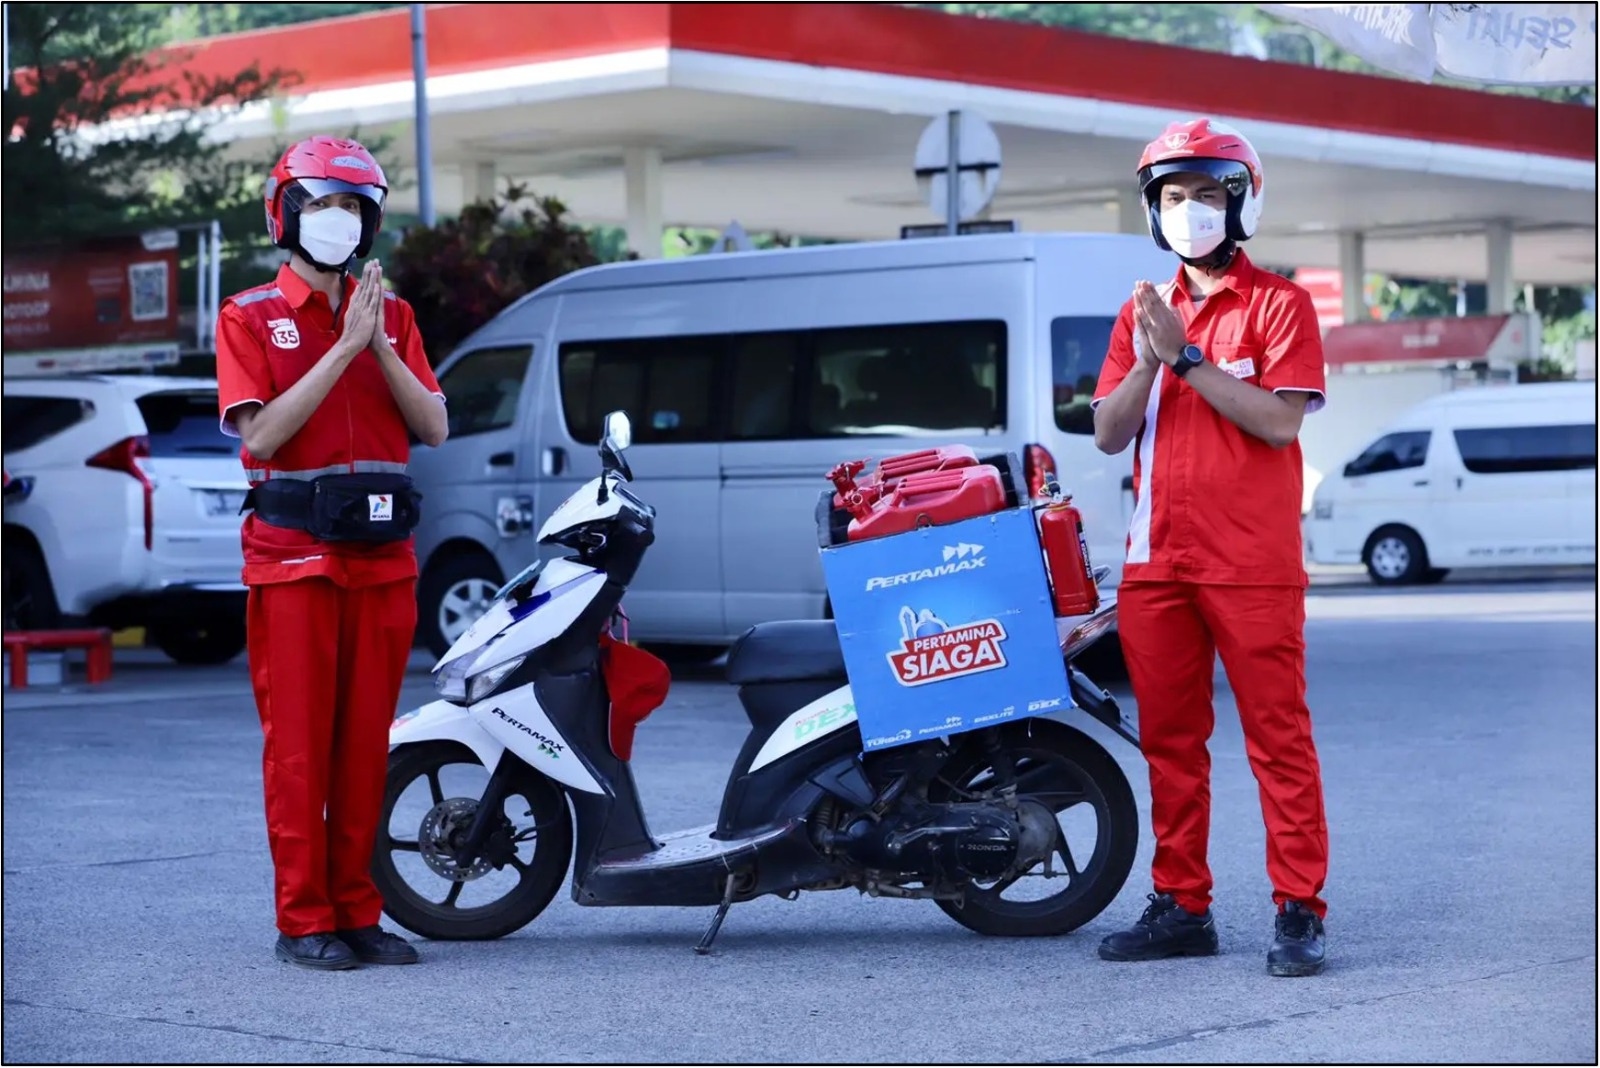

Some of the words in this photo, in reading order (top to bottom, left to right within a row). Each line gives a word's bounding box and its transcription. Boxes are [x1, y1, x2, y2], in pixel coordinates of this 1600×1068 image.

[273, 330, 299, 344] 135
[865, 556, 987, 591] PERTAMAX
[913, 624, 996, 652] PERTAMINA
[902, 639, 997, 680] SIAGA
[1028, 699, 1061, 712] DEX
[491, 707, 565, 752] PERTAMAX
[919, 721, 963, 735] PERTAMAX
[967, 844, 1008, 852] HONDA
